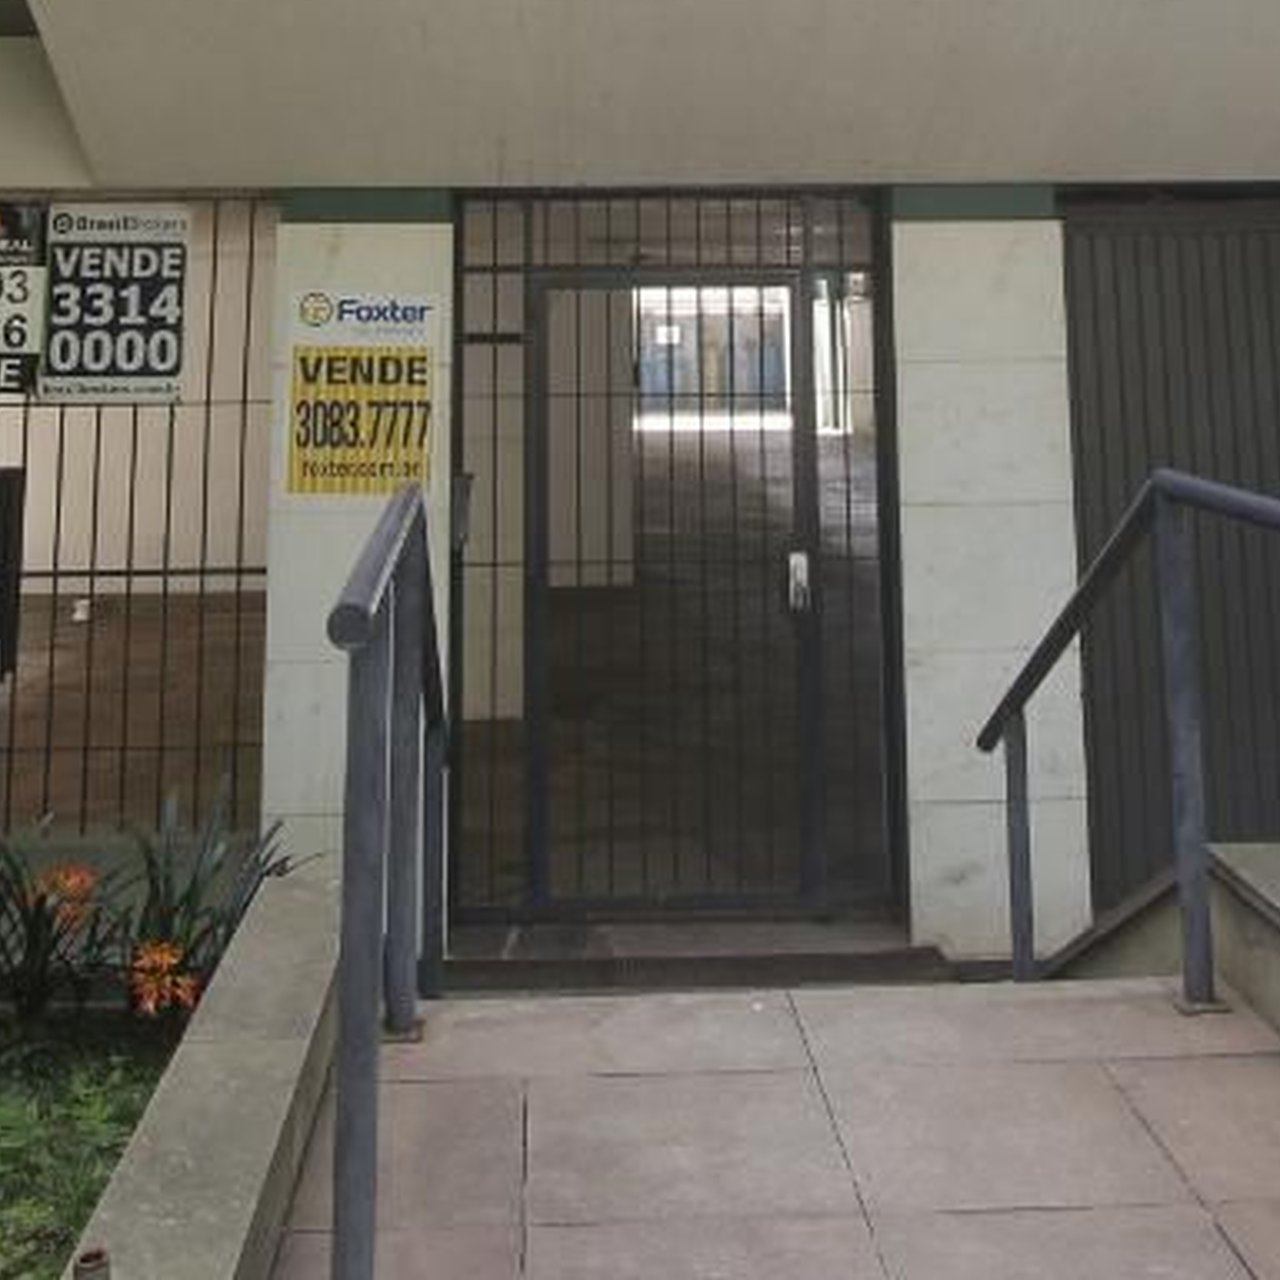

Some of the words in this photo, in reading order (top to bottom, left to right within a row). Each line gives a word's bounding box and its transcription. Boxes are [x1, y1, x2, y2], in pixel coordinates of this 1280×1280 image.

[54, 246, 183, 278] VENDE
[52, 285, 182, 325] 3314
[337, 298, 433, 322] Foxter
[48, 329, 181, 371] 0000
[300, 356, 428, 386] VENDE
[295, 400, 432, 448] 3083.7777
